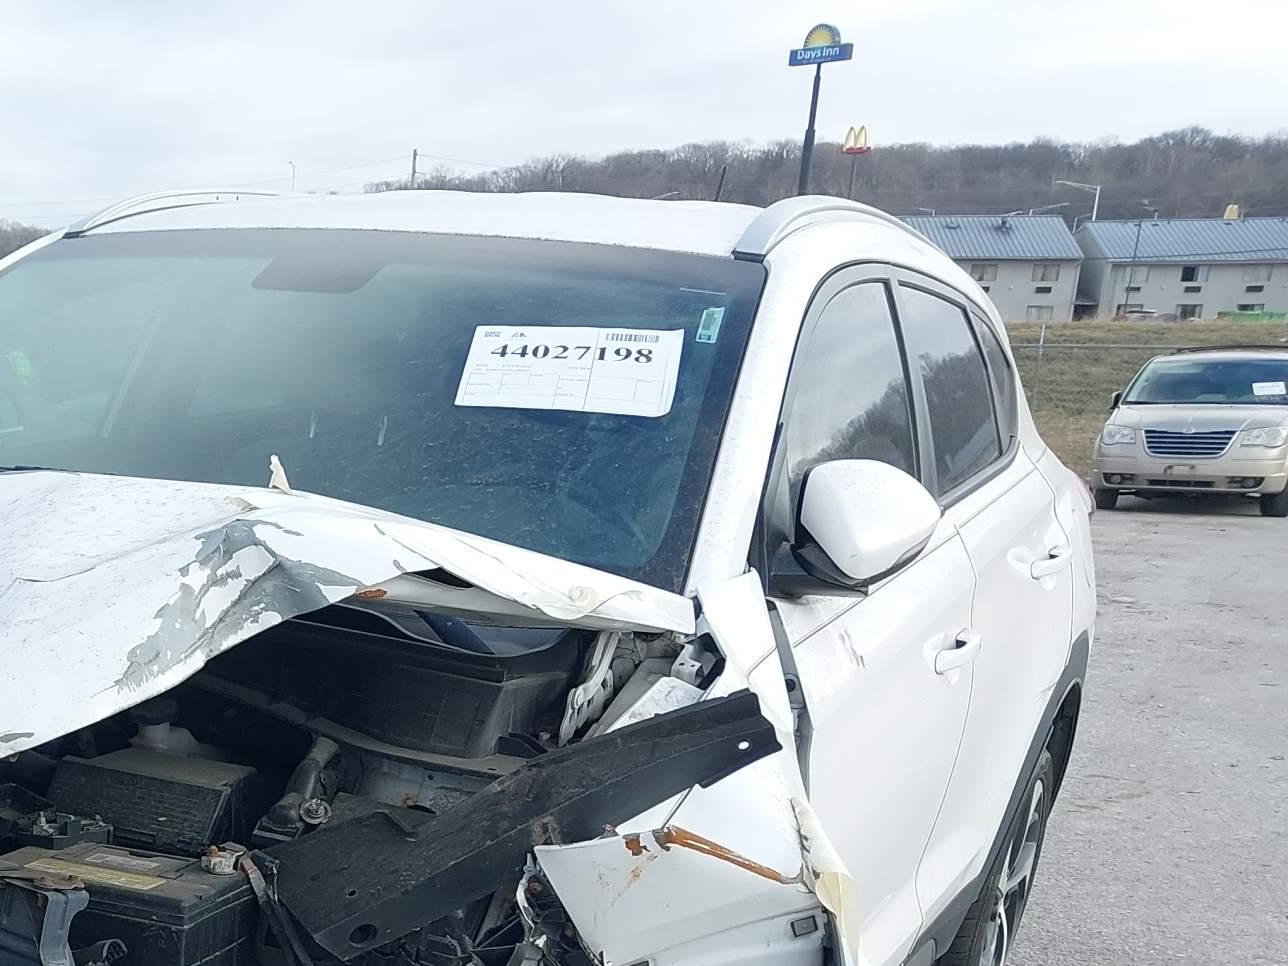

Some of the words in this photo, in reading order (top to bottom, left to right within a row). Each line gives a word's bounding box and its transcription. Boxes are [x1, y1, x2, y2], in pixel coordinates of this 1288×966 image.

[797, 48, 821, 60] Days
[823, 47, 840, 57] Inn
[491, 343, 653, 364] 44027198
